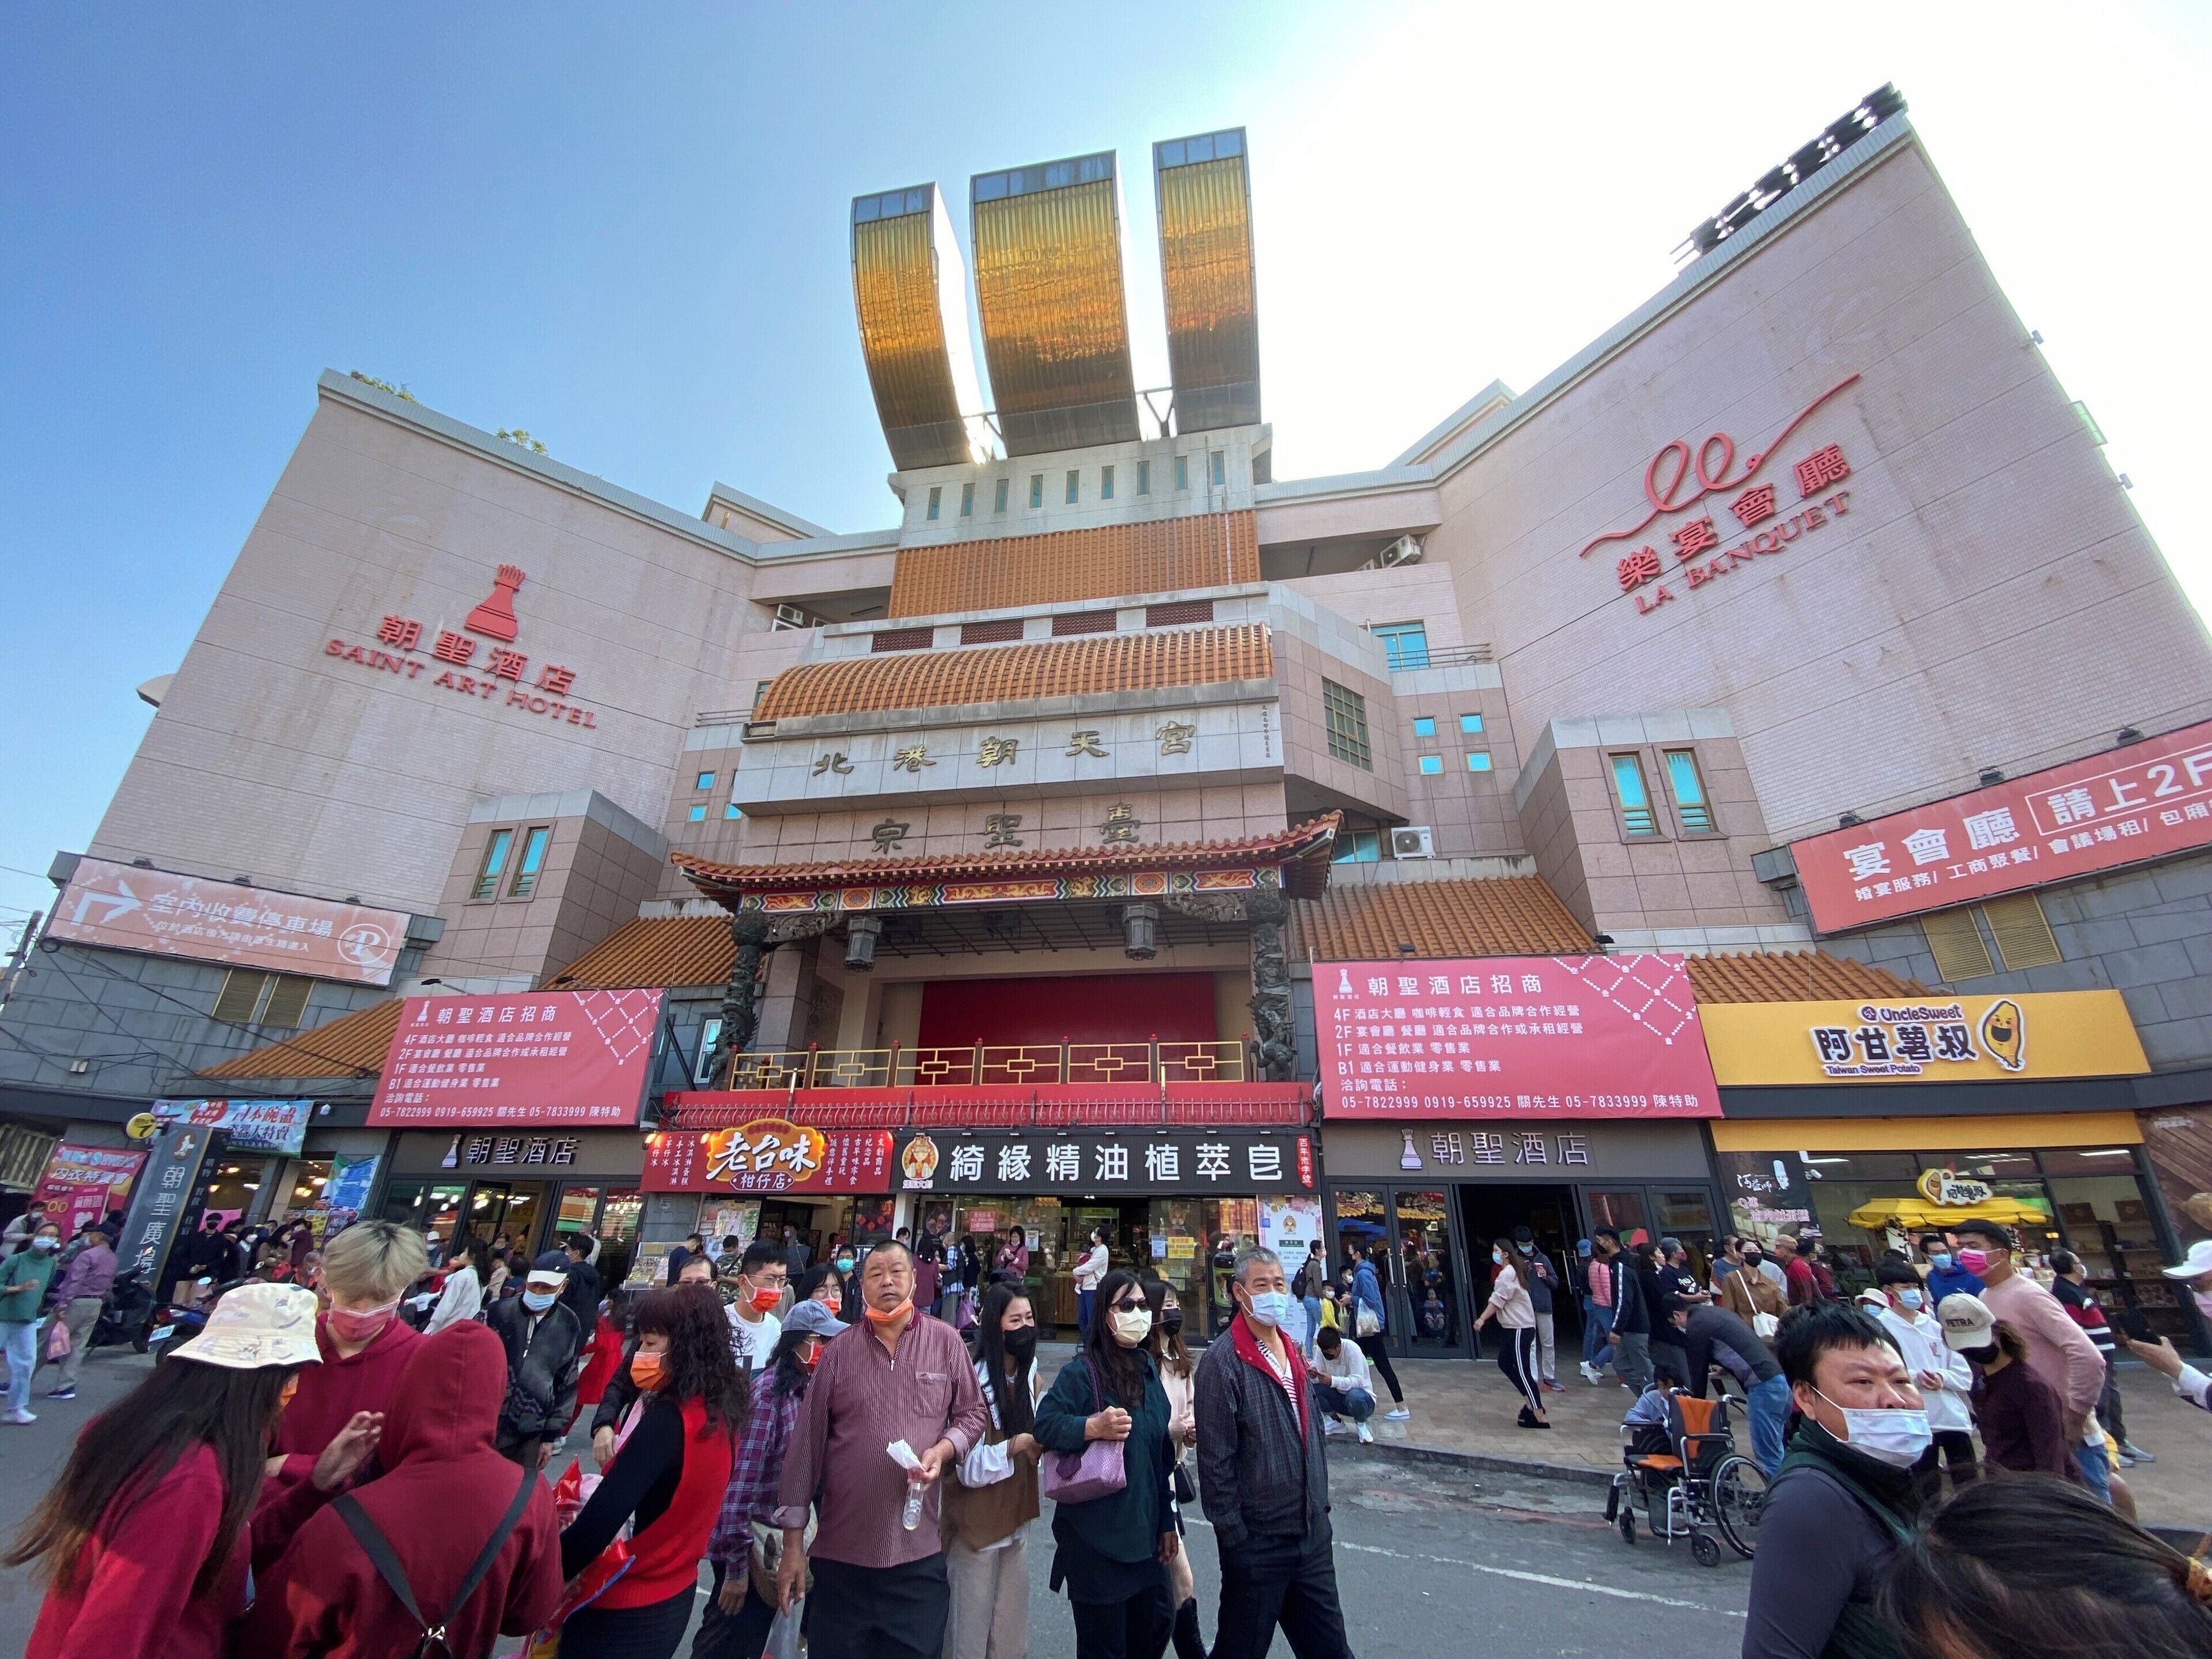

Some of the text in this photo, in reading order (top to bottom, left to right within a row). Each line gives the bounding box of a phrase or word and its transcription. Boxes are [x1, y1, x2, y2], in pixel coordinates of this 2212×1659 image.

[1616, 444, 1851, 591] 樂宴會廳
[1634, 491, 1850, 615] LA BANQUET
[377, 614, 577, 696] 朝聖酒店
[325, 638, 597, 729] SAINT ART HOTEL
[812, 720, 1196, 777] 北港朝天宮
[1843, 752, 2212, 881] 宴會廳 請上2F
[2159, 798, 2212, 827] 包廂
[872, 802, 1141, 855] 宗聖臺
[148, 893, 334, 939] 室內收費停車場
[349, 930, 380, 957] P
[1368, 974, 1542, 997] 朝聖酒店招商
[437, 1005, 557, 1024] 朝聖酒店招商
[1333, 1005, 1580, 1021] 4F 酒店大廳 咖啡輕食 適合品牌合作經營
[1880, 1004, 1962, 1021] UncleSweet
[404, 1032, 572, 1046] 4F 酒店大廳 咖啡輕食 適合品牌合作經營
[1335, 1022, 1584, 1039] 2F 宴會廳 餐廳 適合品牌合作或承租經營
[1815, 1025, 1977, 1060] 阿甘薯叔
[399, 1047, 568, 1060] 2F 宴會廳 餐廳 適合品牌合作或承租經營
[1336, 1041, 1470, 1057] 1F 適合餐飲業 零售業
[394, 1063, 486, 1075] 1F 適合餐飲業 零售業
[1338, 1059, 1501, 1075] B1 適合運動健身業 零售業
[1826, 1064, 1920, 1074] Taiwan Sweet Potato
[388, 1078, 500, 1090] B1 適合運動健身業 零售業
[380, 1106, 621, 1118] 05-7822999 0919-659925 關先生 05-7833999 陳特助
[1342, 1094, 1698, 1108] 05-7822999 0919-659925 關先生 05-7833999 陳特助
[466, 1137, 580, 1164] 朝聖酒店
[650, 1135, 661, 1166] 仔冰
[705, 1131, 816, 1180] 老台味
[863, 1138, 873, 1166] 紀念品
[1299, 1138, 1312, 1184] 百年老字號
[1431, 1131, 1588, 1165] 朝聖酒店
[950, 1142, 1283, 1183] 綺緣精油植萃皂
[740, 1173, 786, 1189] 柑仔店
